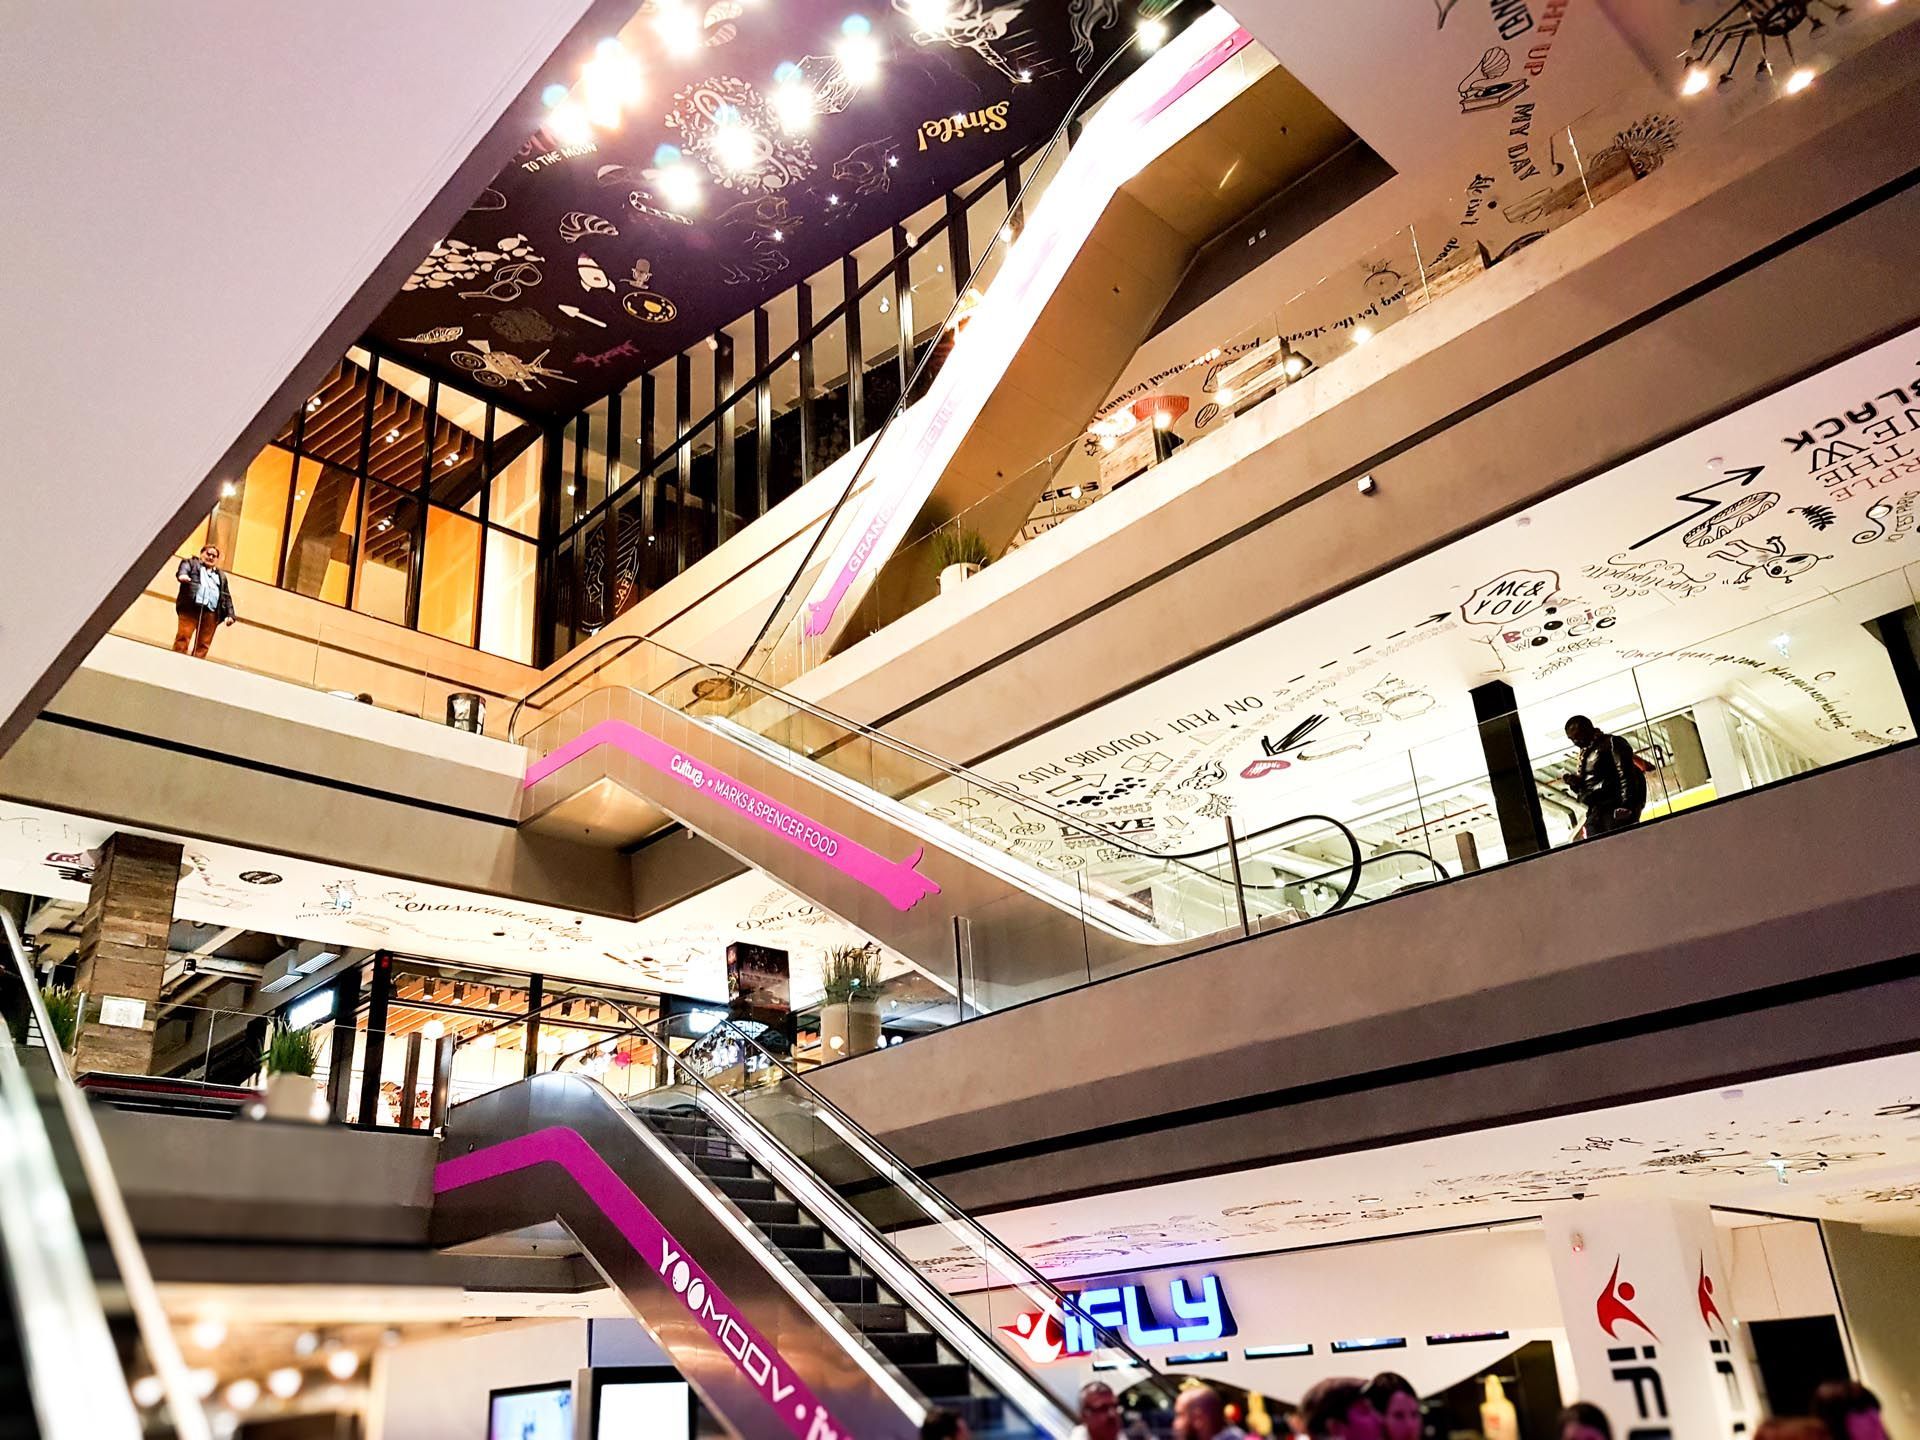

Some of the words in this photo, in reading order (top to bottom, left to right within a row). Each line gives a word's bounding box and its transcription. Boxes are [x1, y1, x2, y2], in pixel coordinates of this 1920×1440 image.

[1524, 43, 1552, 77] UP
[917, 100, 1010, 151] Smile!
[1509, 103, 1535, 136] MY
[521, 160, 541, 173] TO
[536, 150, 561, 166] THE
[1508, 142, 1541, 181] DAY
[1816, 442, 1914, 489] THE
[1473, 600, 1533, 615] YOU
[1167, 708, 1221, 735] PEUT
[1223, 695, 1264, 716] ON
[1064, 730, 1165, 768] TOUJOURS
[1018, 762, 1067, 785] PLUS
[670, 754, 705, 789] Cultura
[714, 779, 749, 809] MARKS
[754, 801, 805, 840] SPENCER
[803, 826, 838, 857] FOOD
[659, 1236, 796, 1403] YOOMOOV
[1063, 1274, 1225, 1353] iFLY
